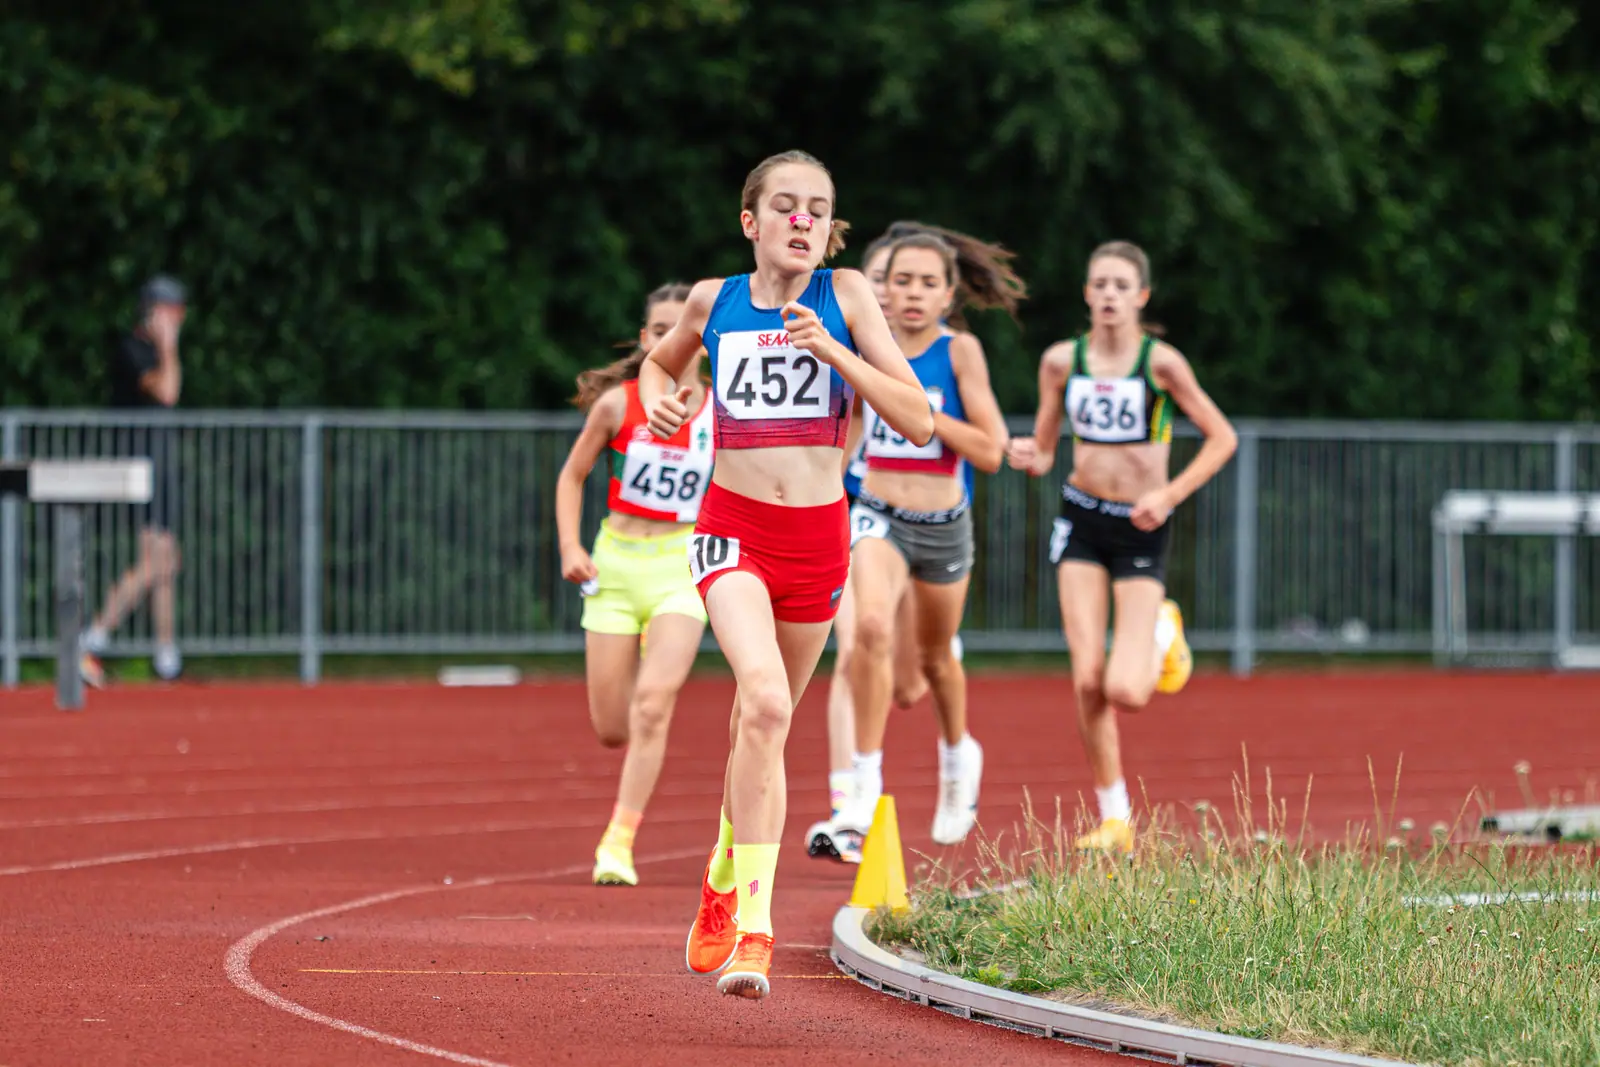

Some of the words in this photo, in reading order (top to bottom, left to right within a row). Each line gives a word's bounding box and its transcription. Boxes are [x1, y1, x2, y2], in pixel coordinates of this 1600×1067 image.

[726, 355, 820, 407] 452
[1076, 397, 1137, 431] 436
[629, 462, 700, 501] 458
[693, 535, 729, 574] 10
